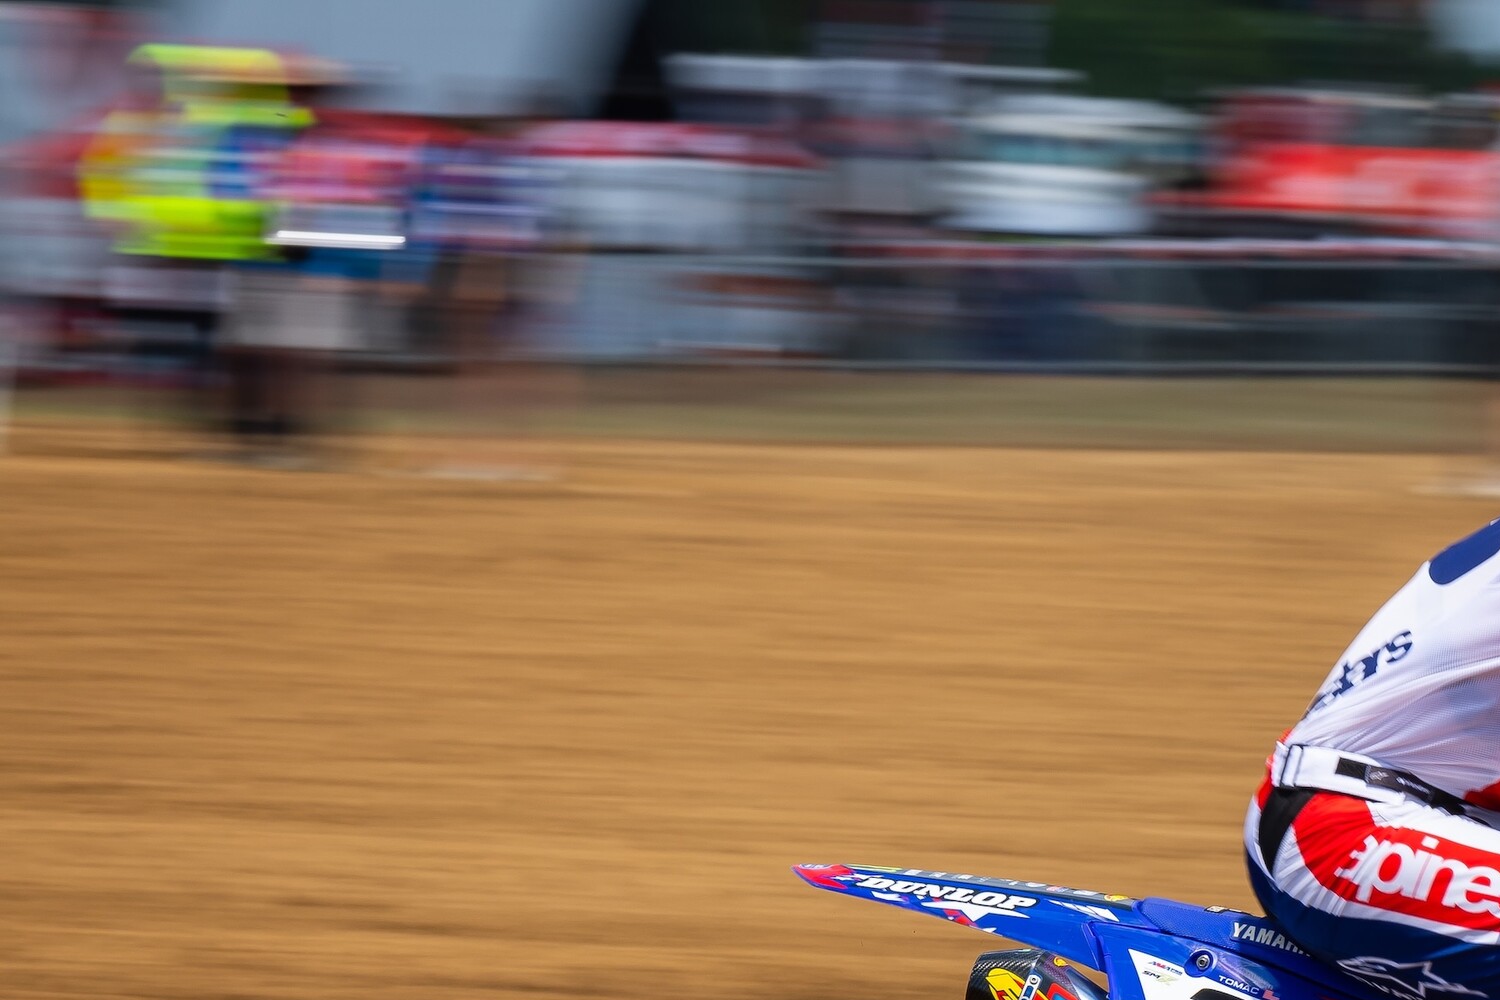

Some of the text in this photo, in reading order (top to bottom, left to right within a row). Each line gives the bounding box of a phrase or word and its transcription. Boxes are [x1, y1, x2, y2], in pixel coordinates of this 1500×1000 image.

[856, 877, 1038, 910] DUNLOP
[1232, 922, 1311, 957] YAMAH
[1218, 974, 1260, 996] TOMAC
